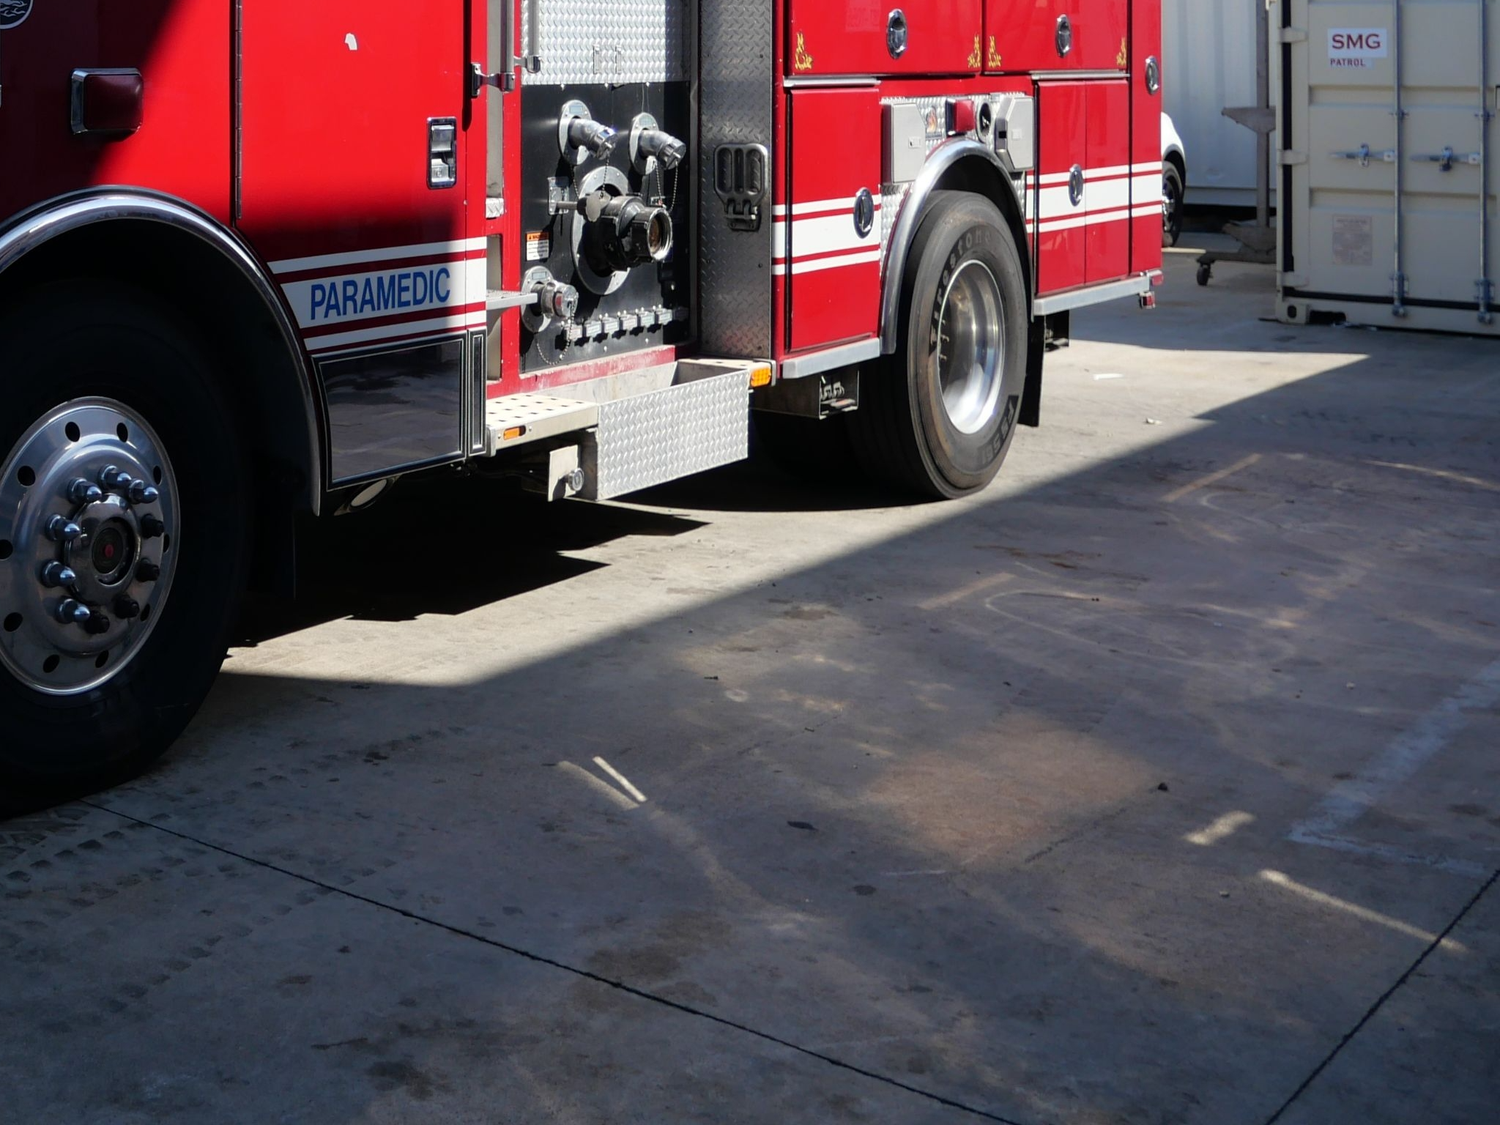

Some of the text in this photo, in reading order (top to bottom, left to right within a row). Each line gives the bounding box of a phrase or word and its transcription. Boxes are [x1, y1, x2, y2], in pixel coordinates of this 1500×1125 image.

[1332, 33, 1381, 50] SMG
[1330, 58, 1366, 67] PATROL
[310, 267, 451, 320] PARAMEDIC
